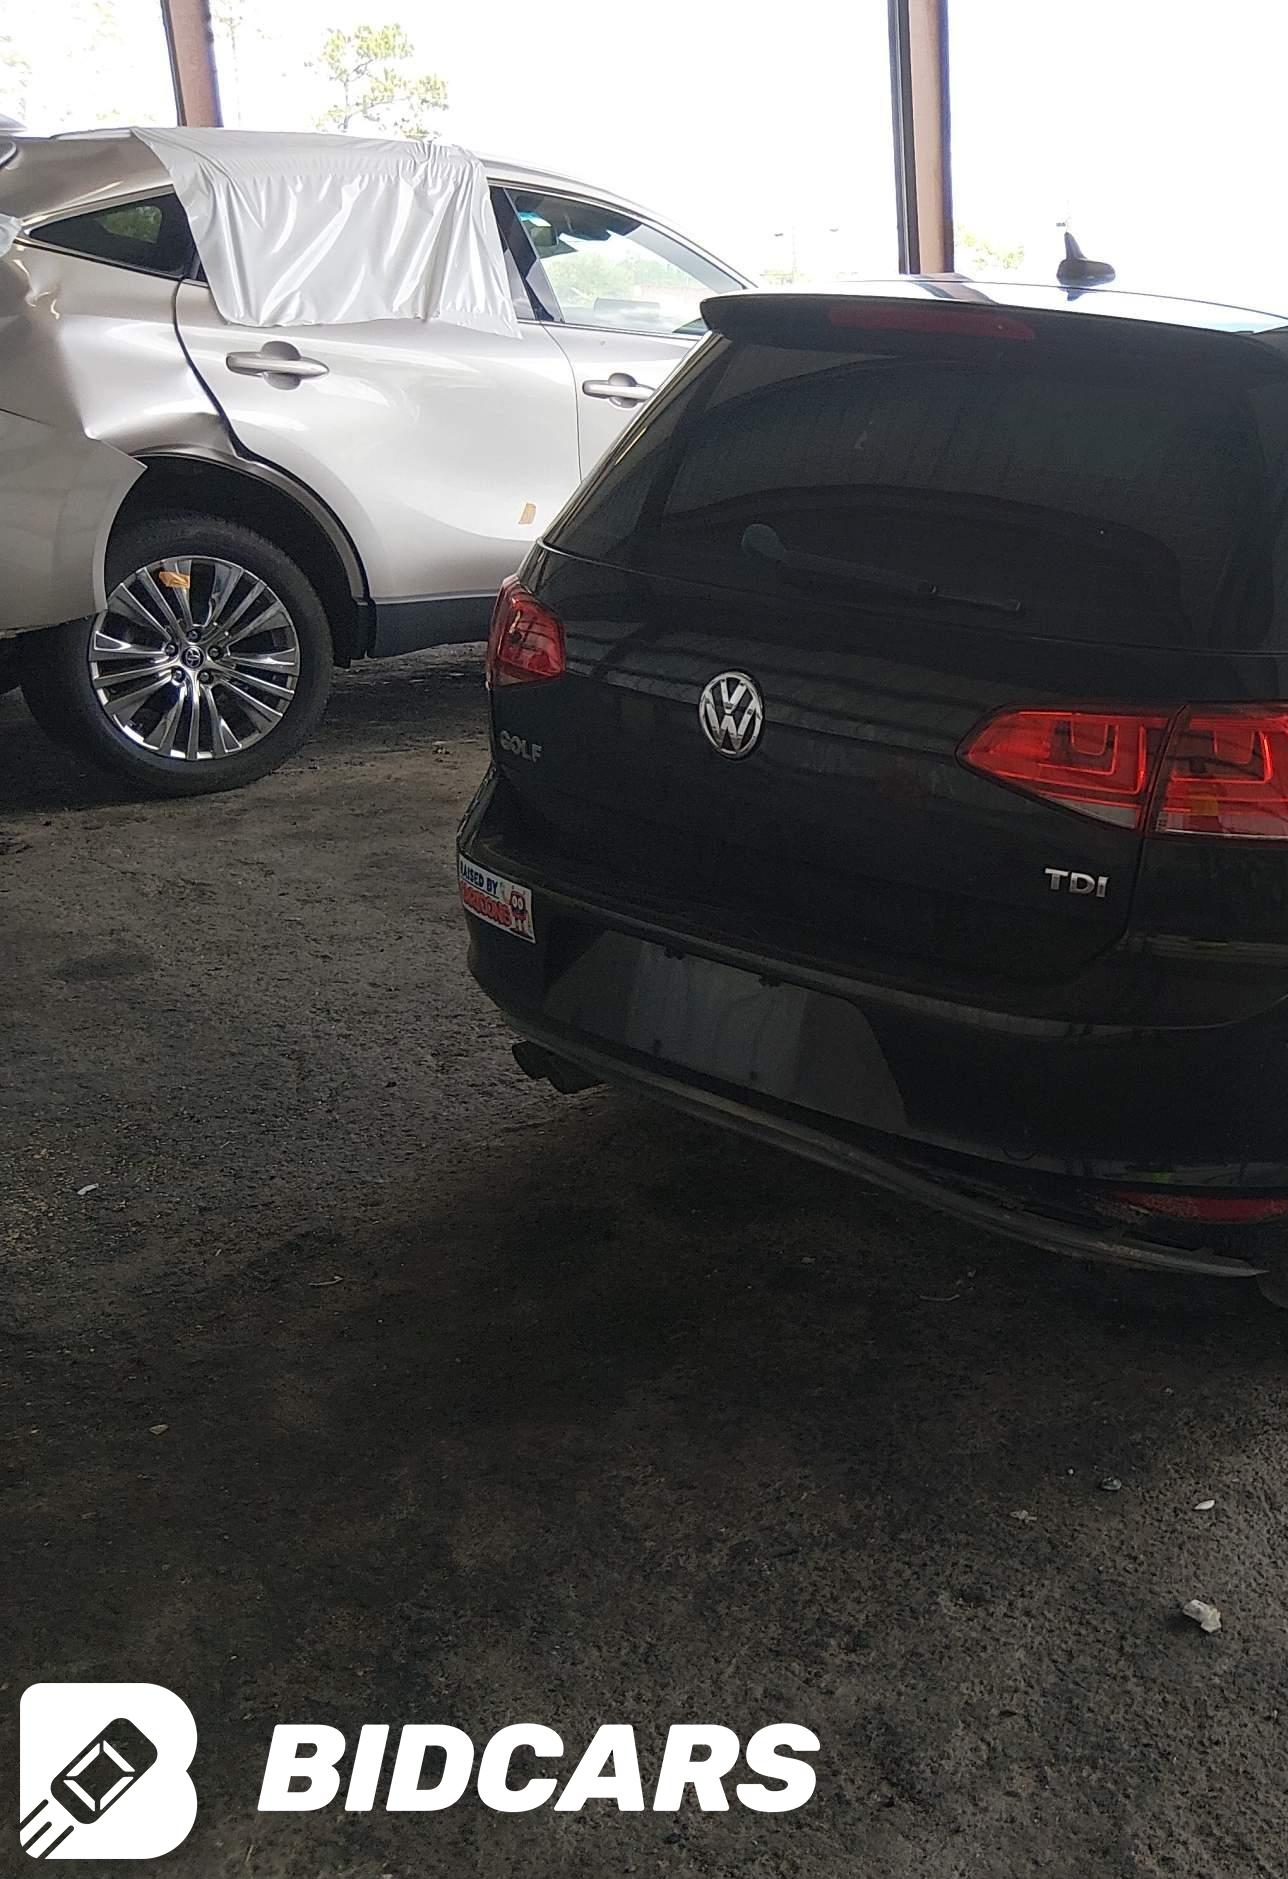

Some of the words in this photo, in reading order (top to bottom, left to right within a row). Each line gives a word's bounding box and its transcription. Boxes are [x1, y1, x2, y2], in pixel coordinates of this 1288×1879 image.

[500, 730, 542, 763] GOLF
[486, 877, 499, 896] BY
[1044, 867, 1109, 898] TDI
